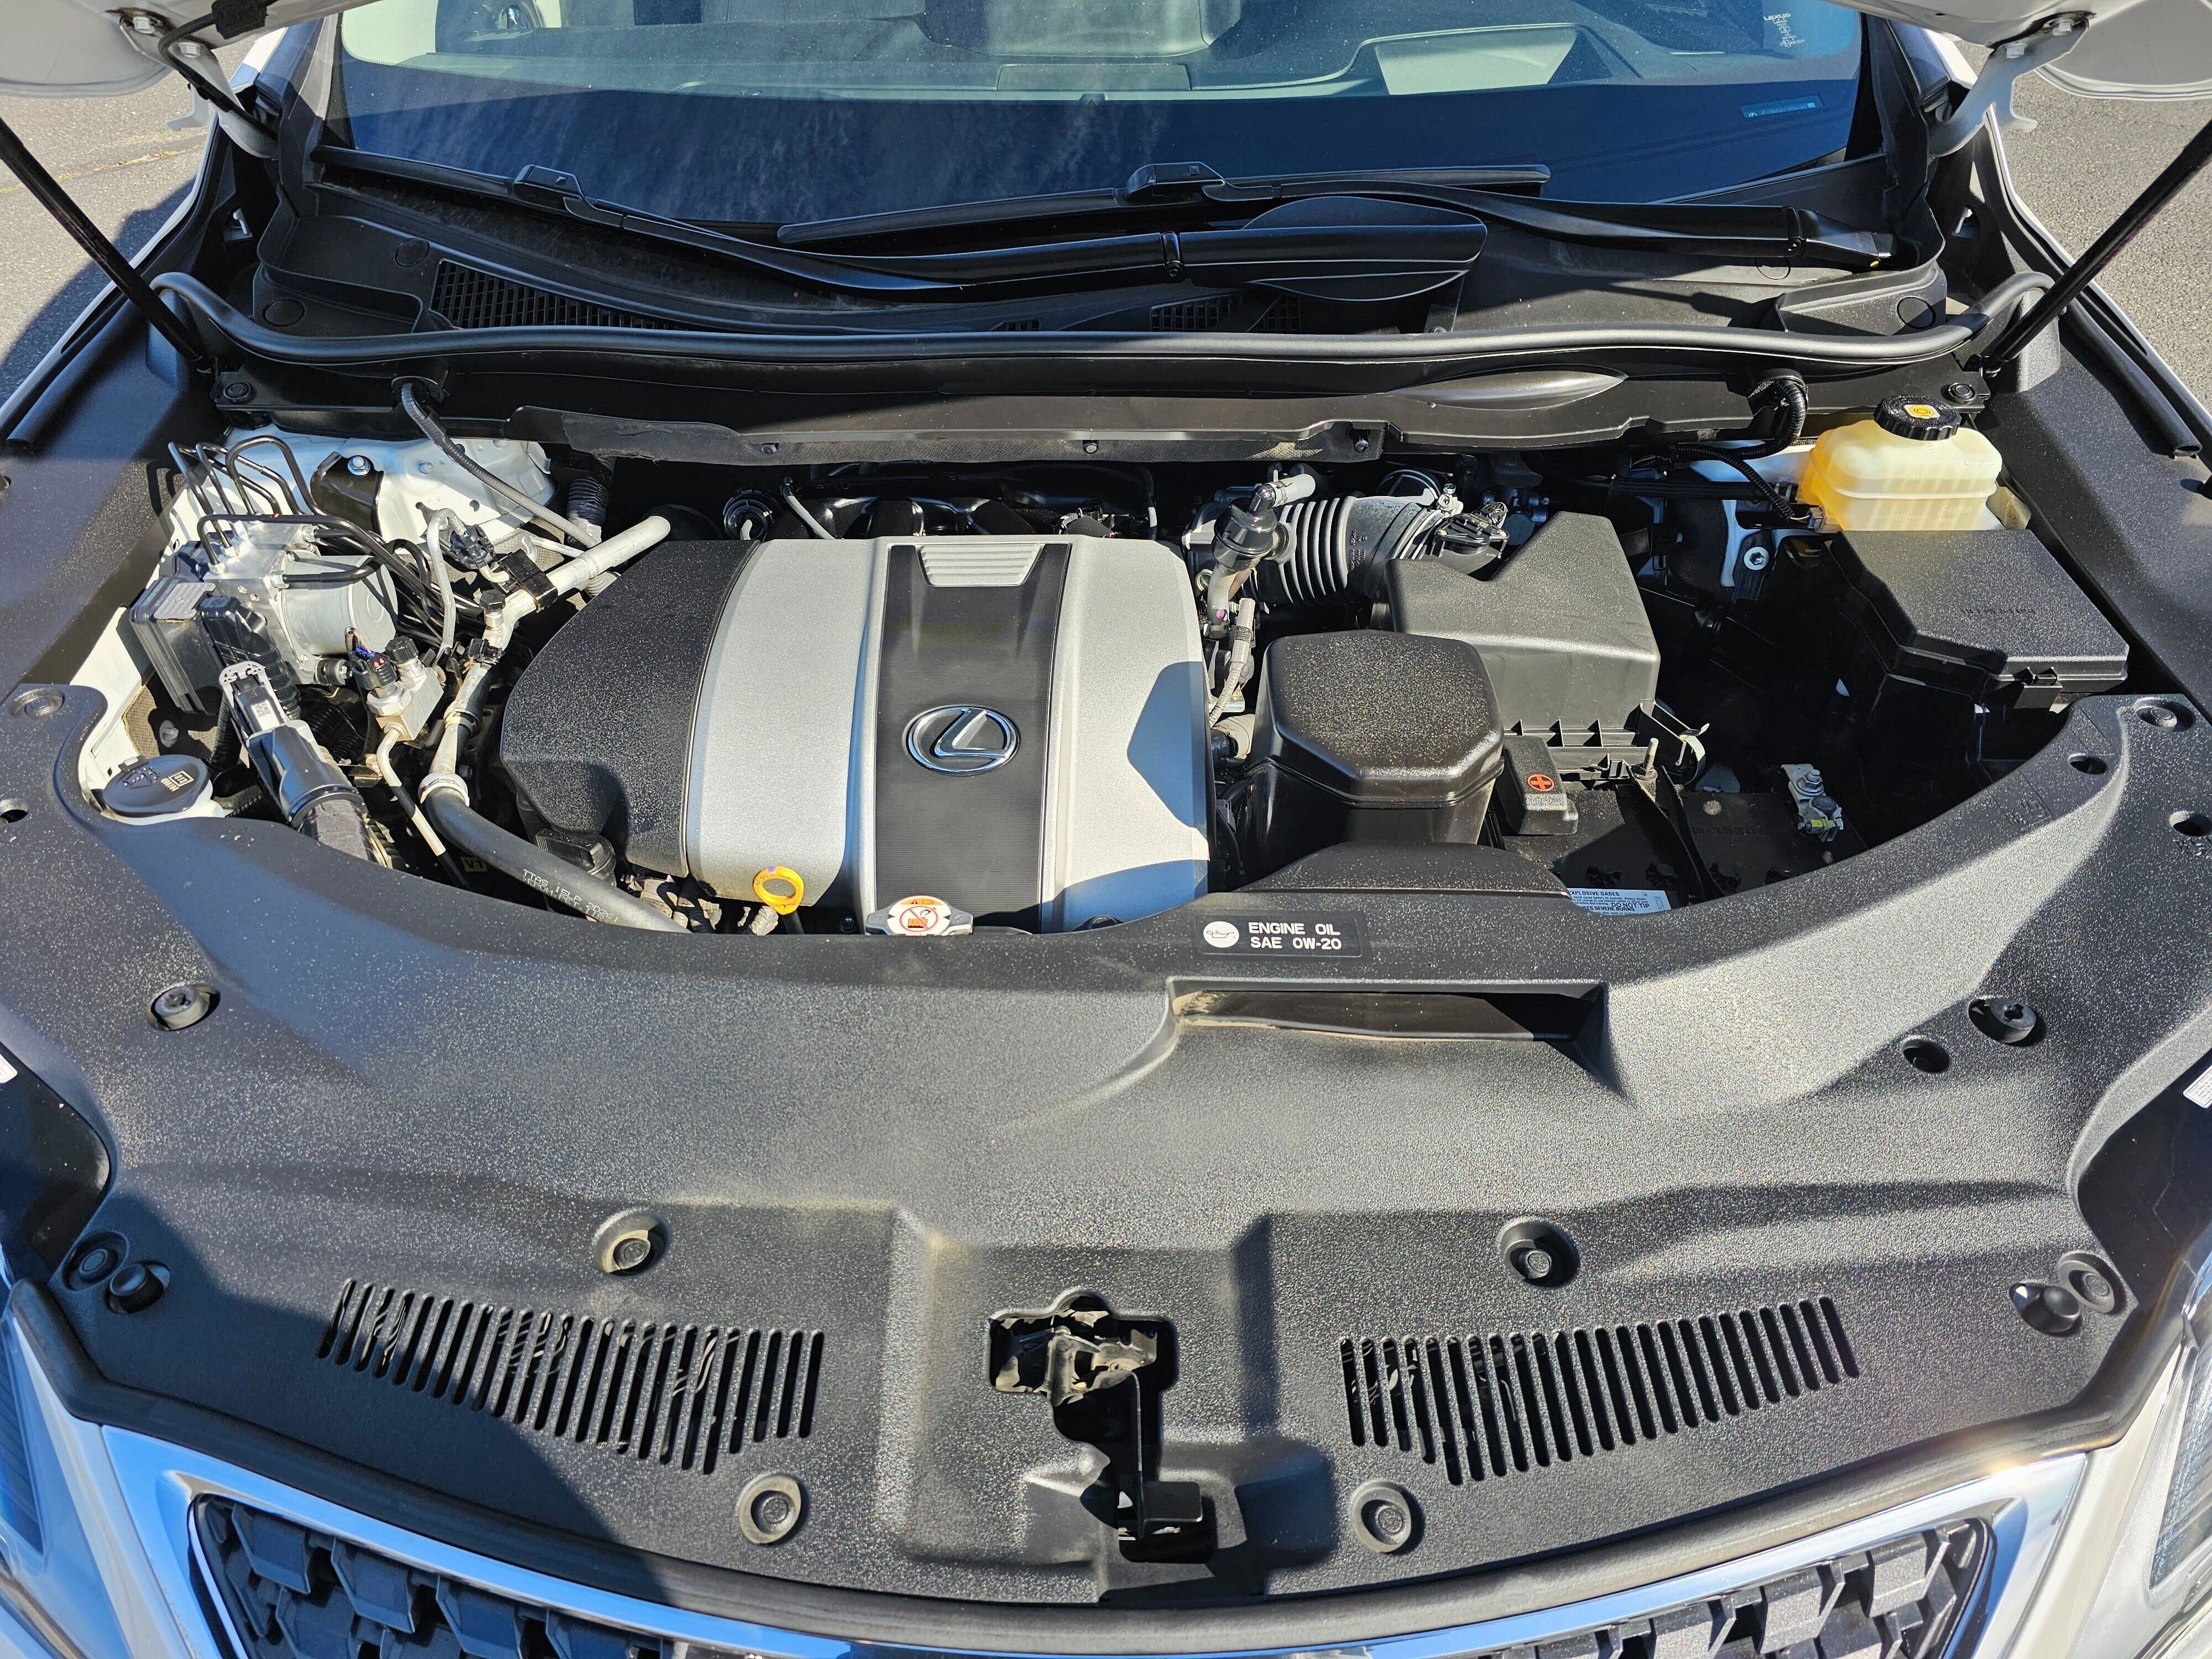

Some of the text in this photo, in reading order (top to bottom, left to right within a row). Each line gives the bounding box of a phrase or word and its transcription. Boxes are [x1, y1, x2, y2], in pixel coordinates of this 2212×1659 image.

[523, 869, 549, 887] TTAS
[1248, 922, 1341, 936] ENGINE OIL
[1250, 937, 1342, 950] SAE 0W-20
